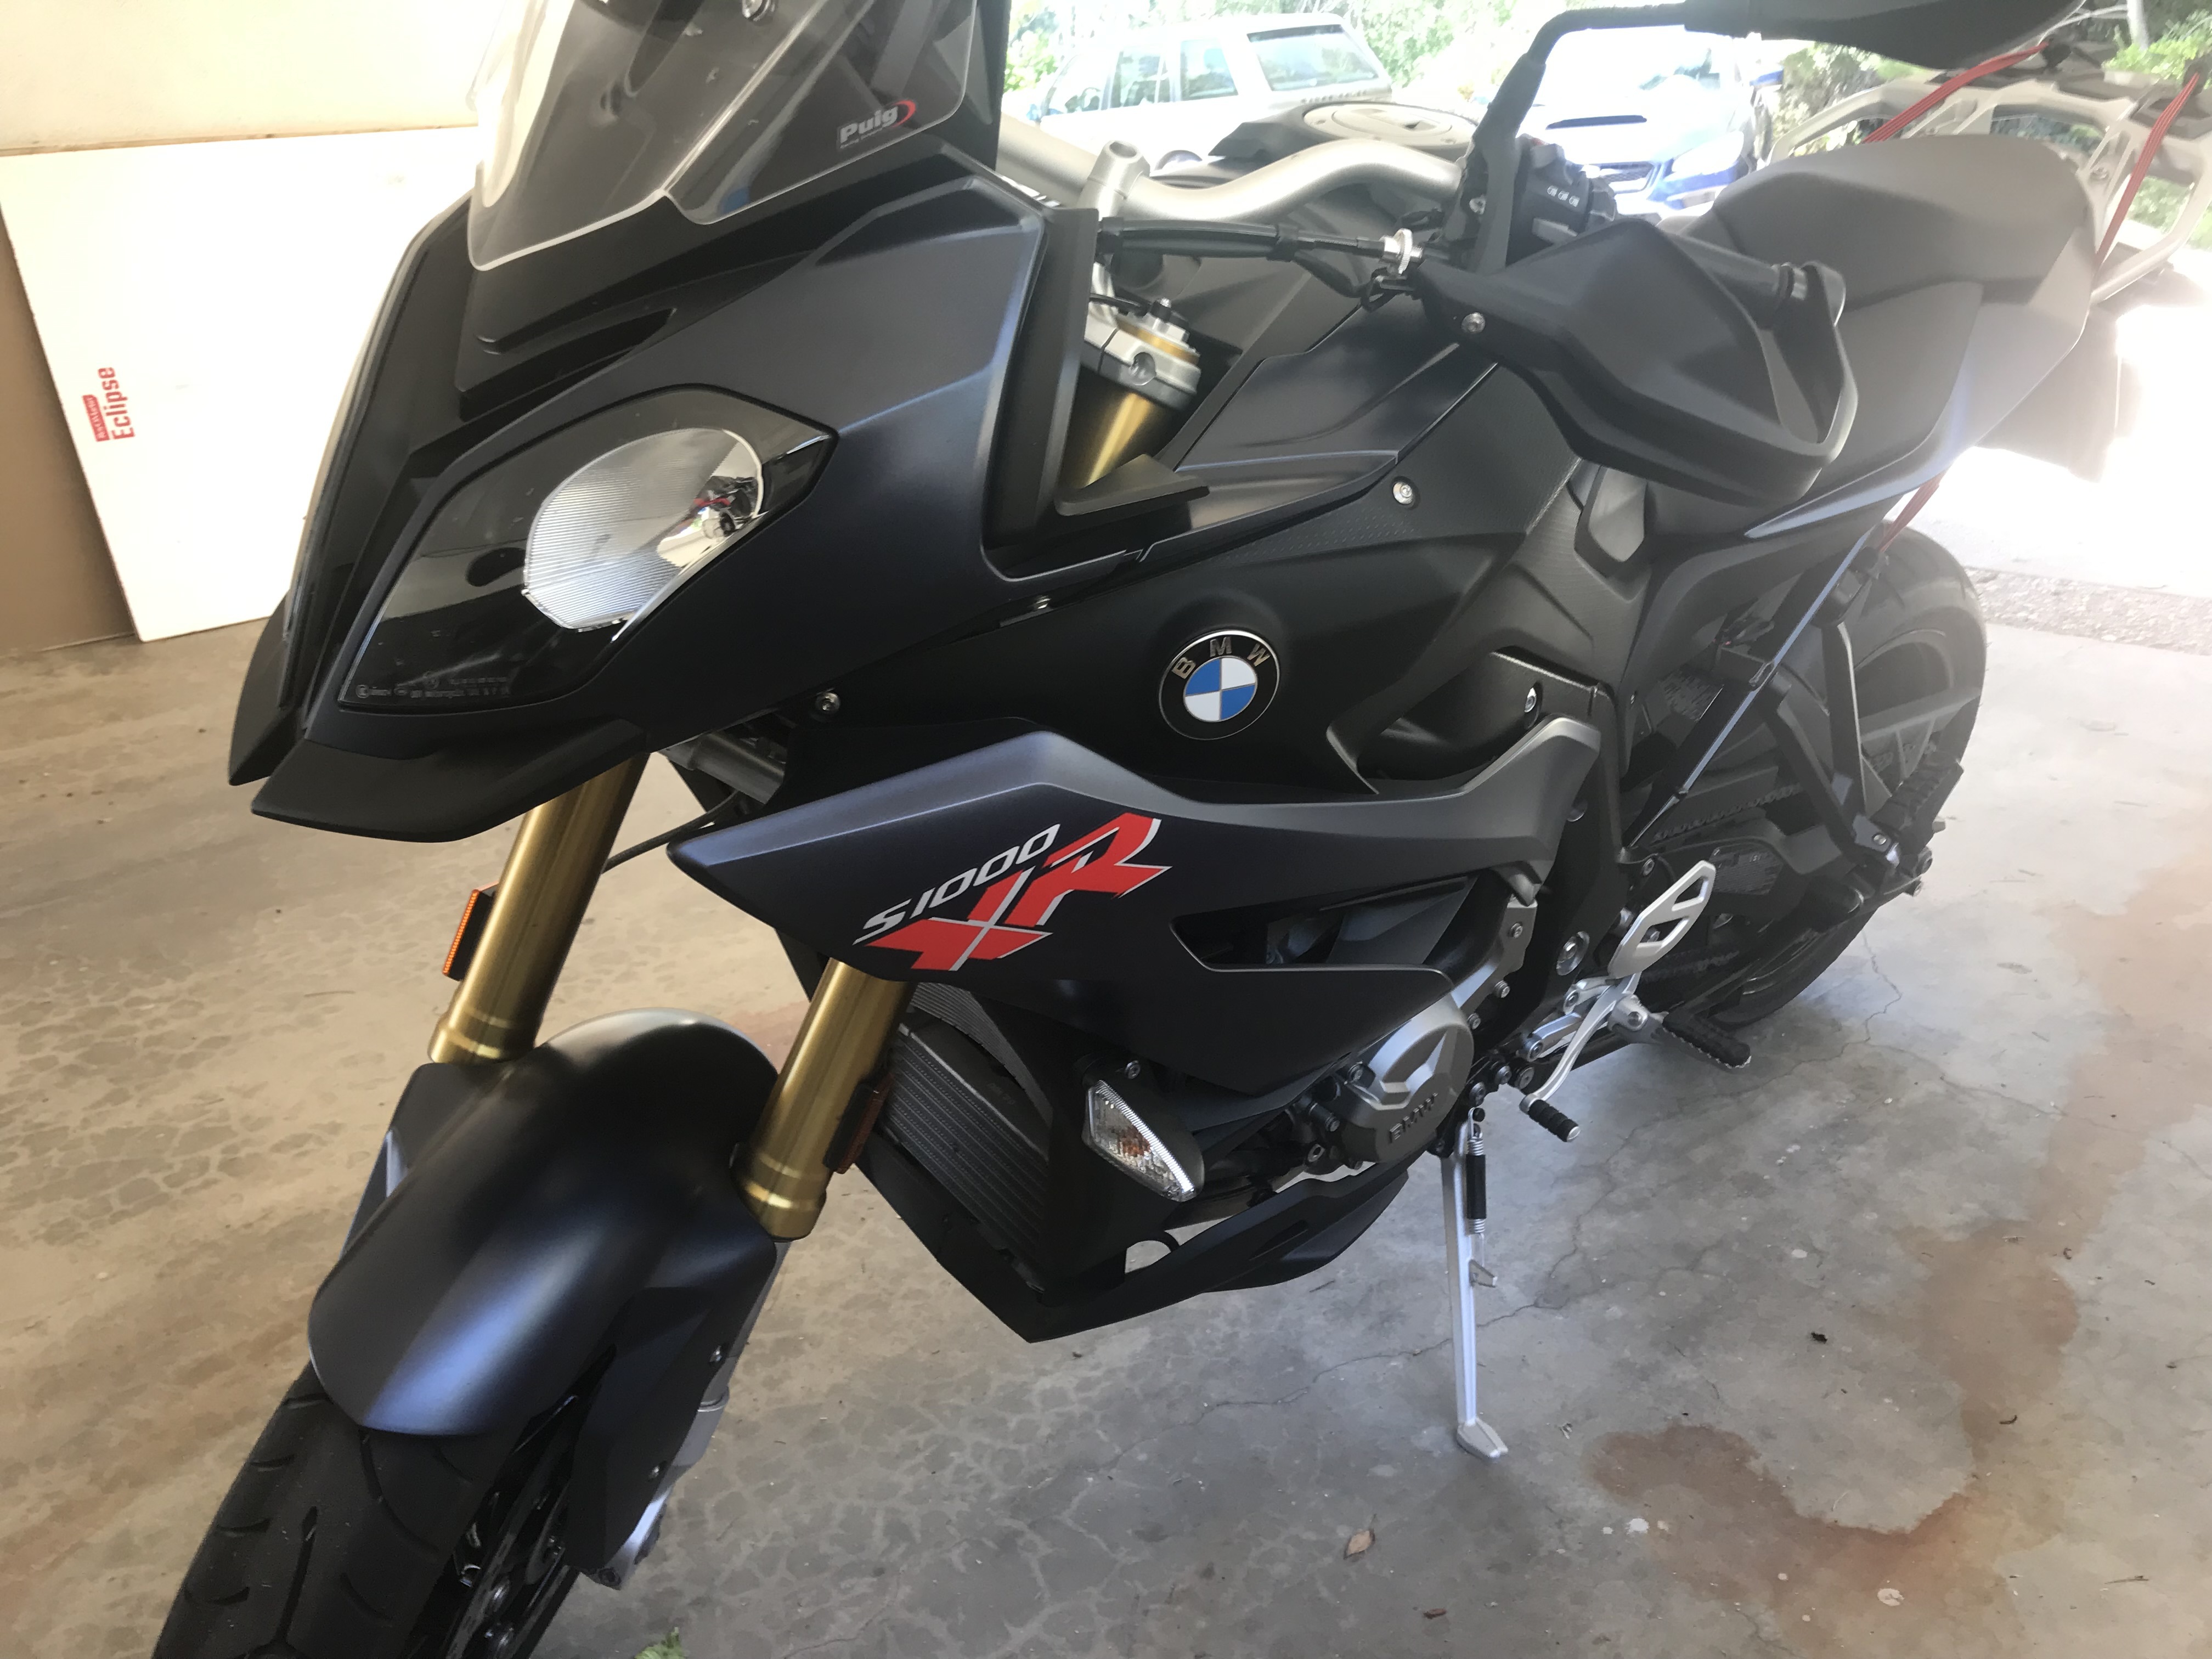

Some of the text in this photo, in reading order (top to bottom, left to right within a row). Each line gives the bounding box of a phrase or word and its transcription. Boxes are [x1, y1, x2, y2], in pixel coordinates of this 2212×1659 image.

[839, 106, 899, 143] Puig
[98, 367, 135, 439] Eclipse
[1172, 636, 1271, 679] BMW
[865, 812, 1173, 972] XR
[1389, 1092, 1438, 1143] BMW
